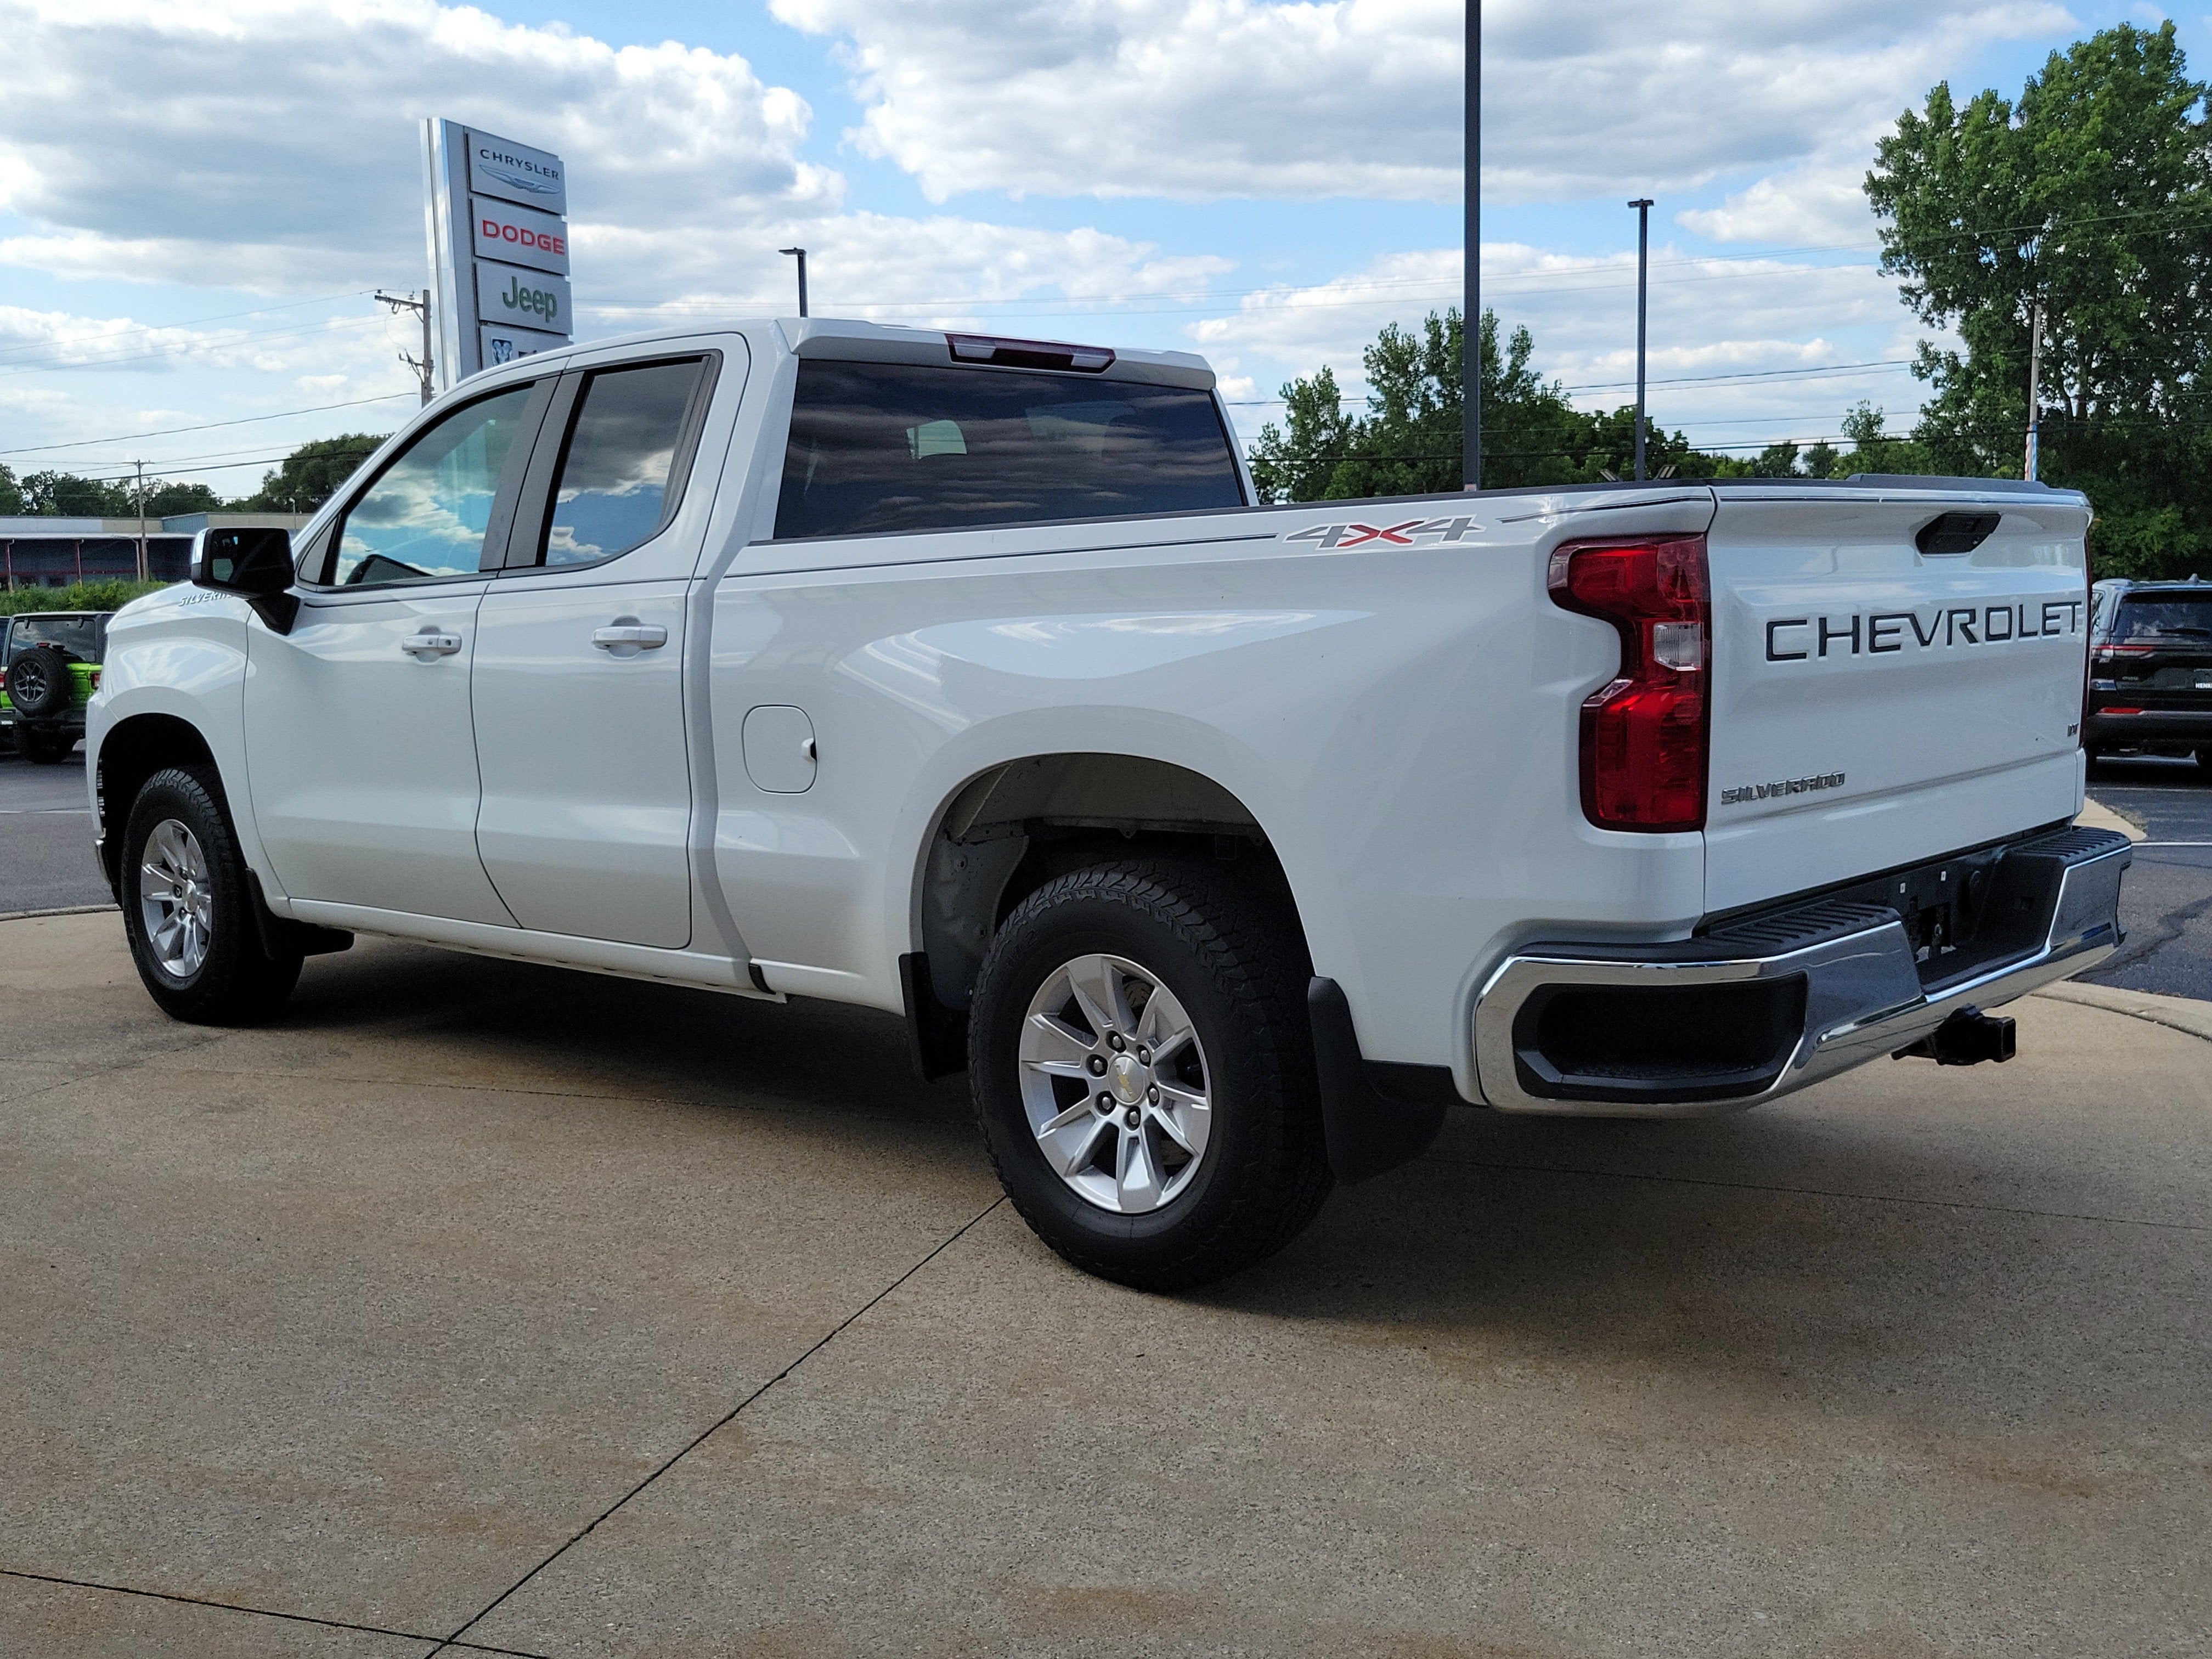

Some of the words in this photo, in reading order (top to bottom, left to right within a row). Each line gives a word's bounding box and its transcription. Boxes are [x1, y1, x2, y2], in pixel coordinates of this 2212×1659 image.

[480, 149, 559, 180] CHRYSLER
[483, 220, 565, 255] DODGE
[503, 276, 557, 322] Jeep
[1765, 601, 2082, 661] CHEVROLET
[1721, 771, 1845, 805] SILVERADO
